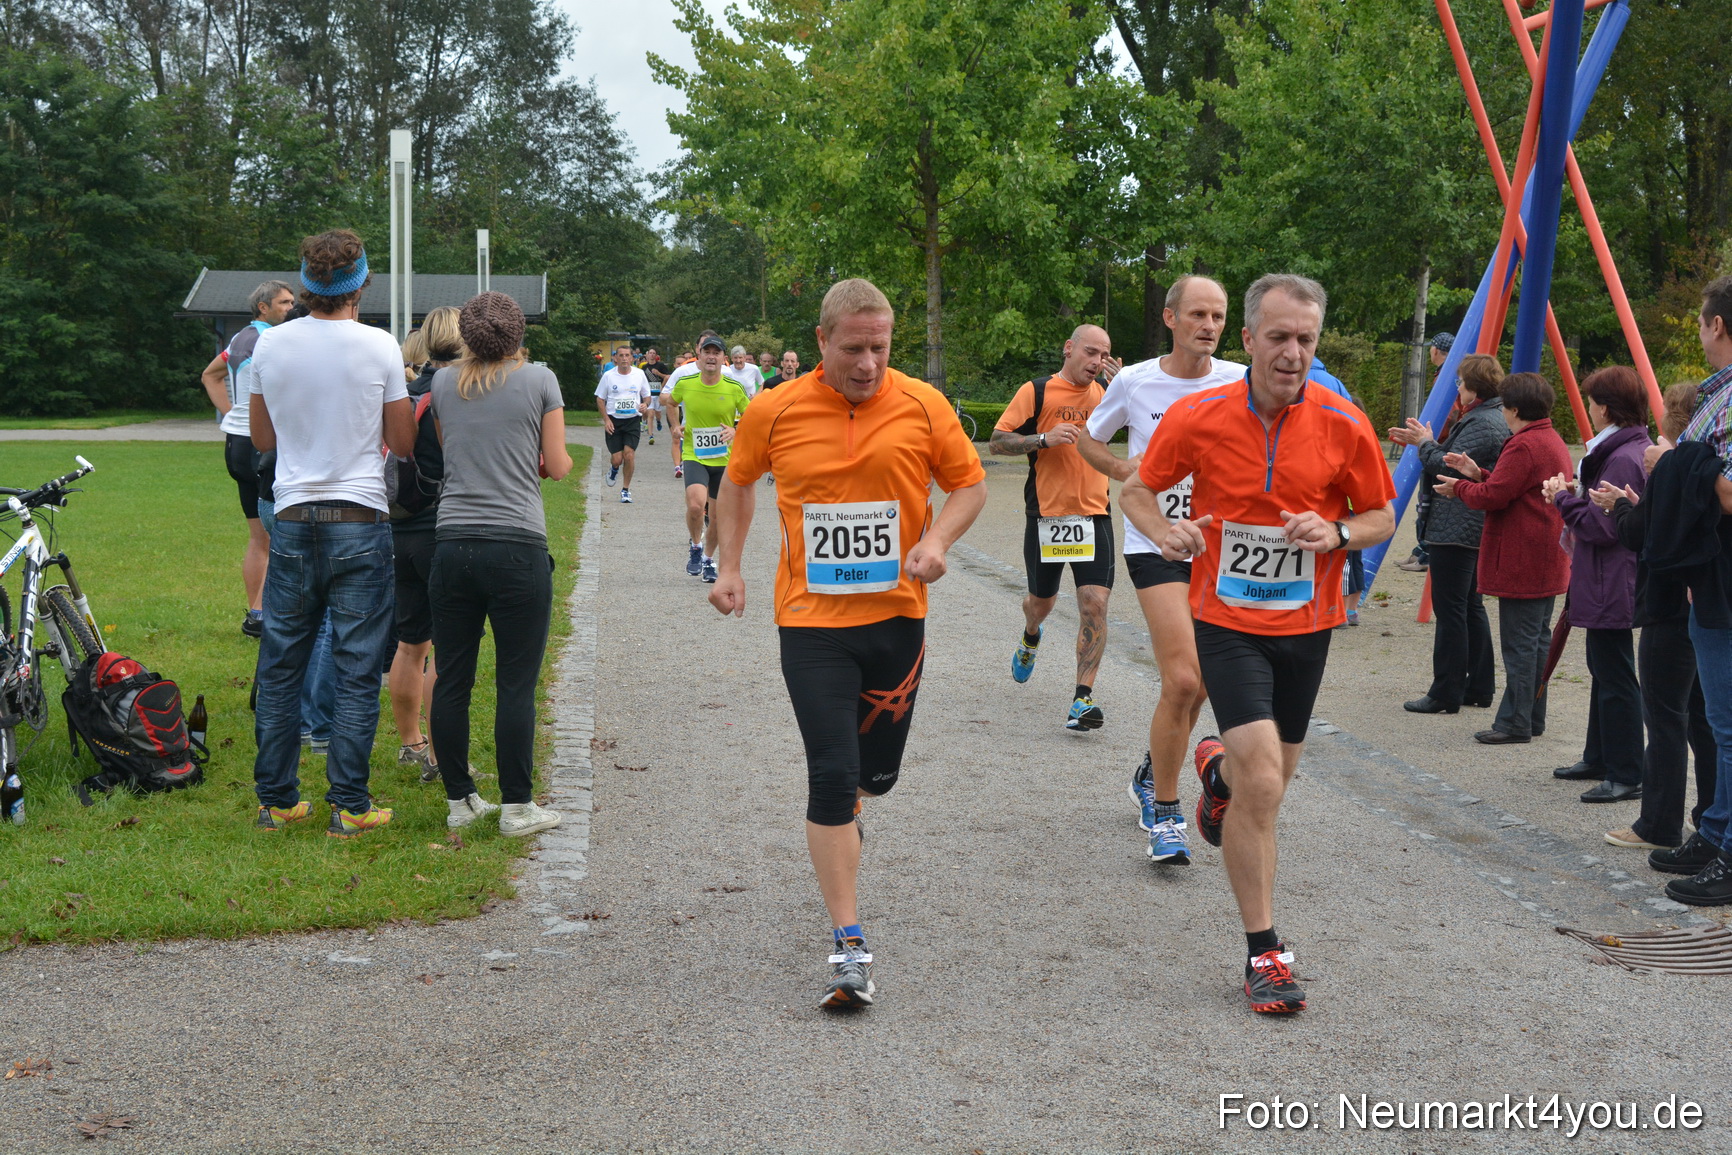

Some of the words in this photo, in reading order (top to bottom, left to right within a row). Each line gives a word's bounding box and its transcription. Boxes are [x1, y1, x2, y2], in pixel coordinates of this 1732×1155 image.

[617, 401, 635, 409] 2052
[805, 512, 834, 521] PARTL
[836, 511, 883, 521] Neumarkt
[1050, 524, 1084, 543] 220
[1224, 529, 1256, 541] PARTL
[812, 524, 891, 559] 2055
[1, 545, 22, 568] STING
[1052, 547, 1084, 555] Christian
[1229, 543, 1303, 578] 2271
[835, 568, 869, 581] Peter
[1242, 584, 1287, 599] Johann
